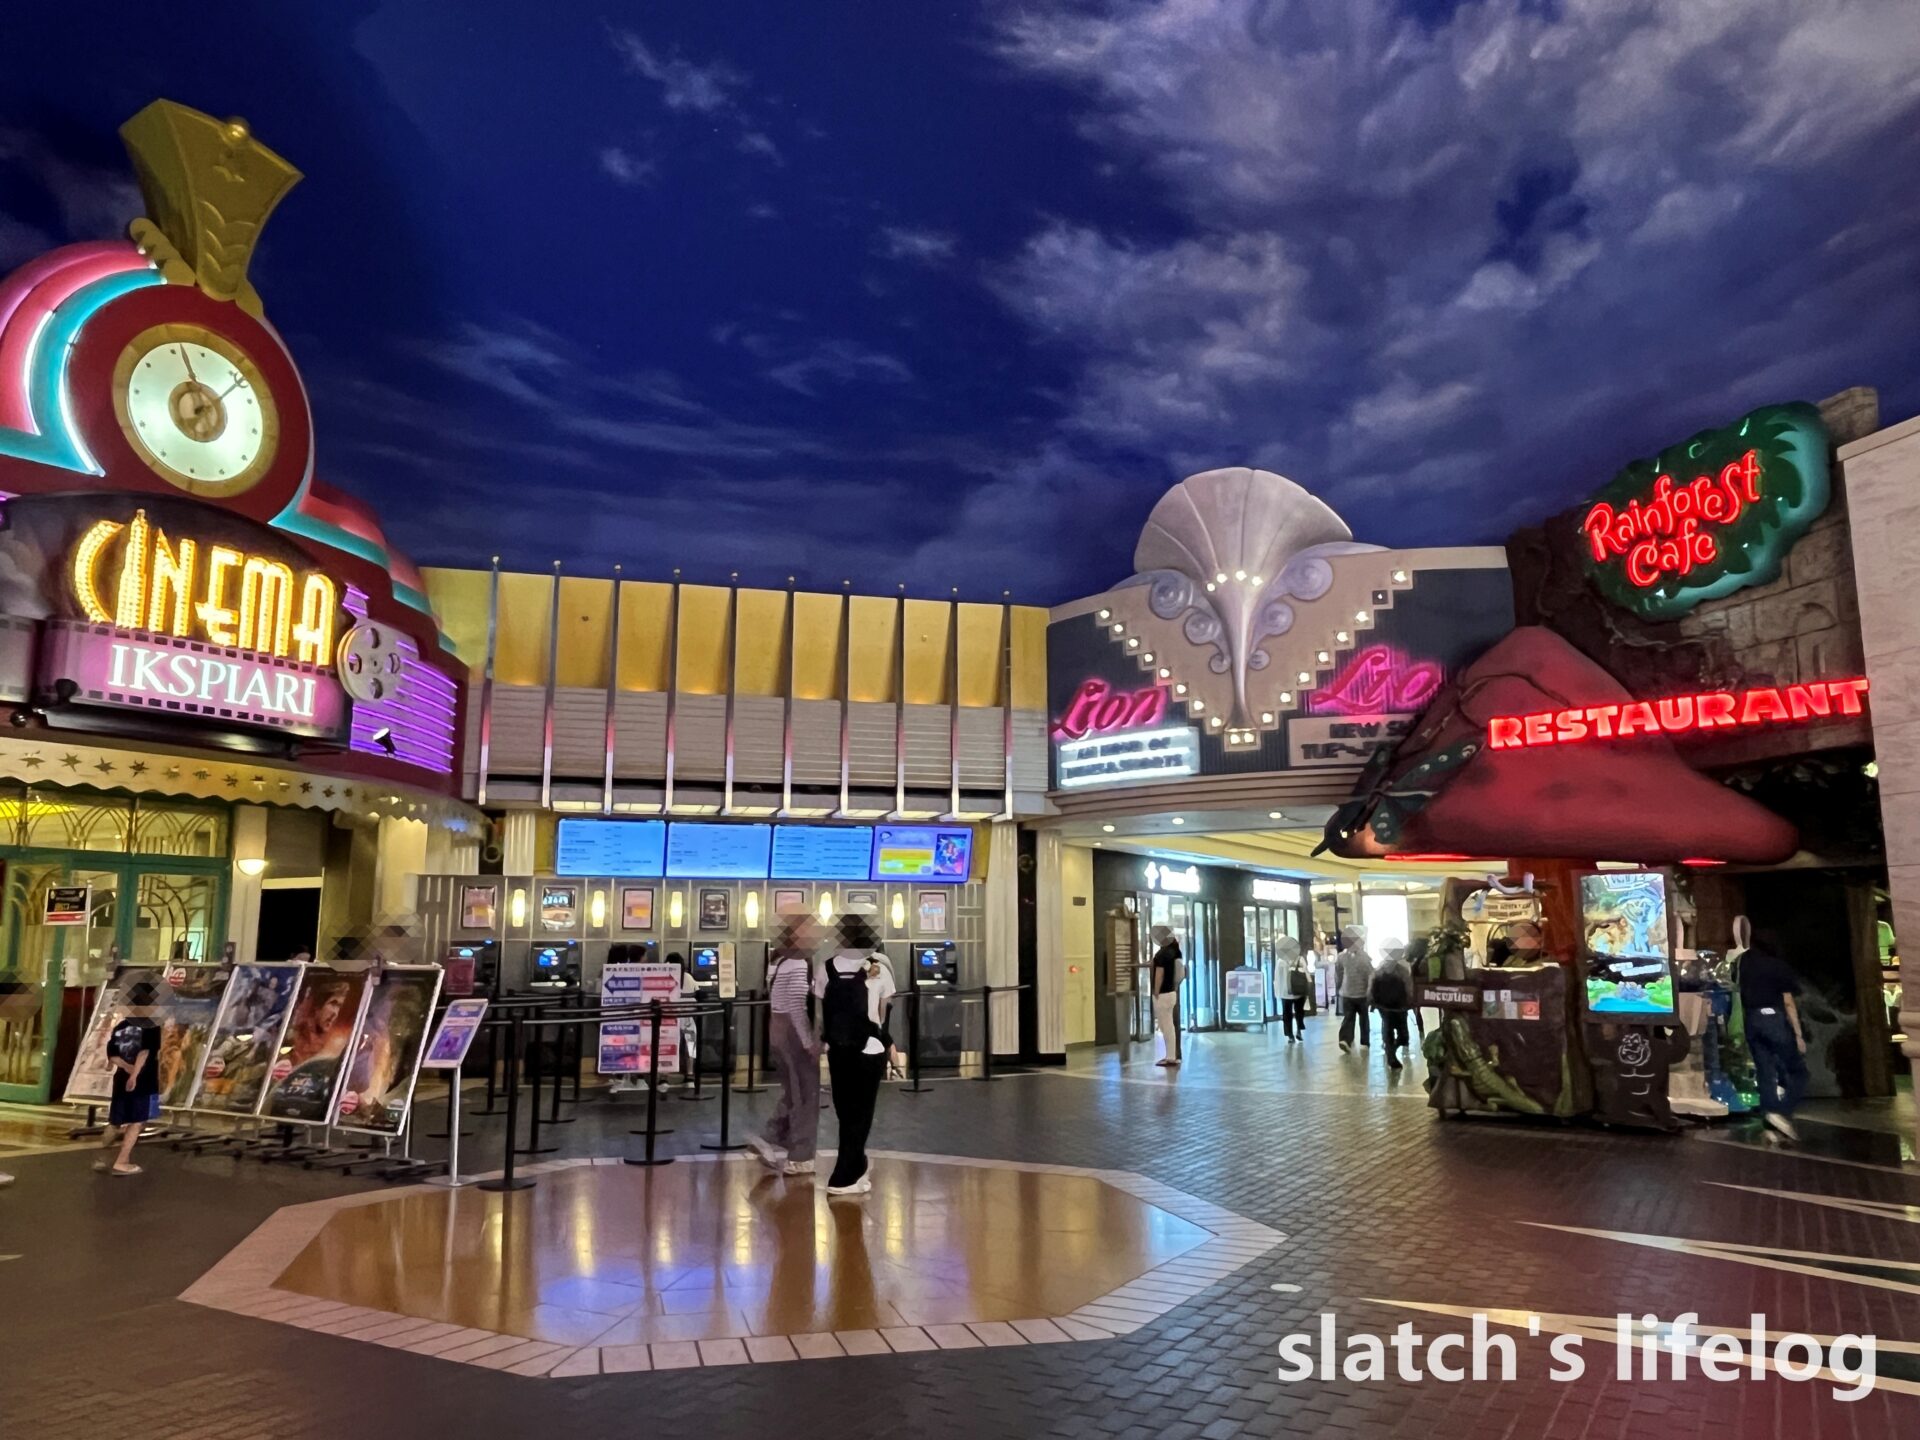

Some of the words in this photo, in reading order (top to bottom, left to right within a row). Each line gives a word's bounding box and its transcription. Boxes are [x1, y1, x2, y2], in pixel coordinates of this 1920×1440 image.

[1626, 517, 1717, 587] Cafe
[74, 508, 337, 667] CINEMA
[107, 643, 317, 718] IKSPIARI
[1050, 682, 1161, 740] Lion
[1488, 679, 1869, 749] RESTAURANT
